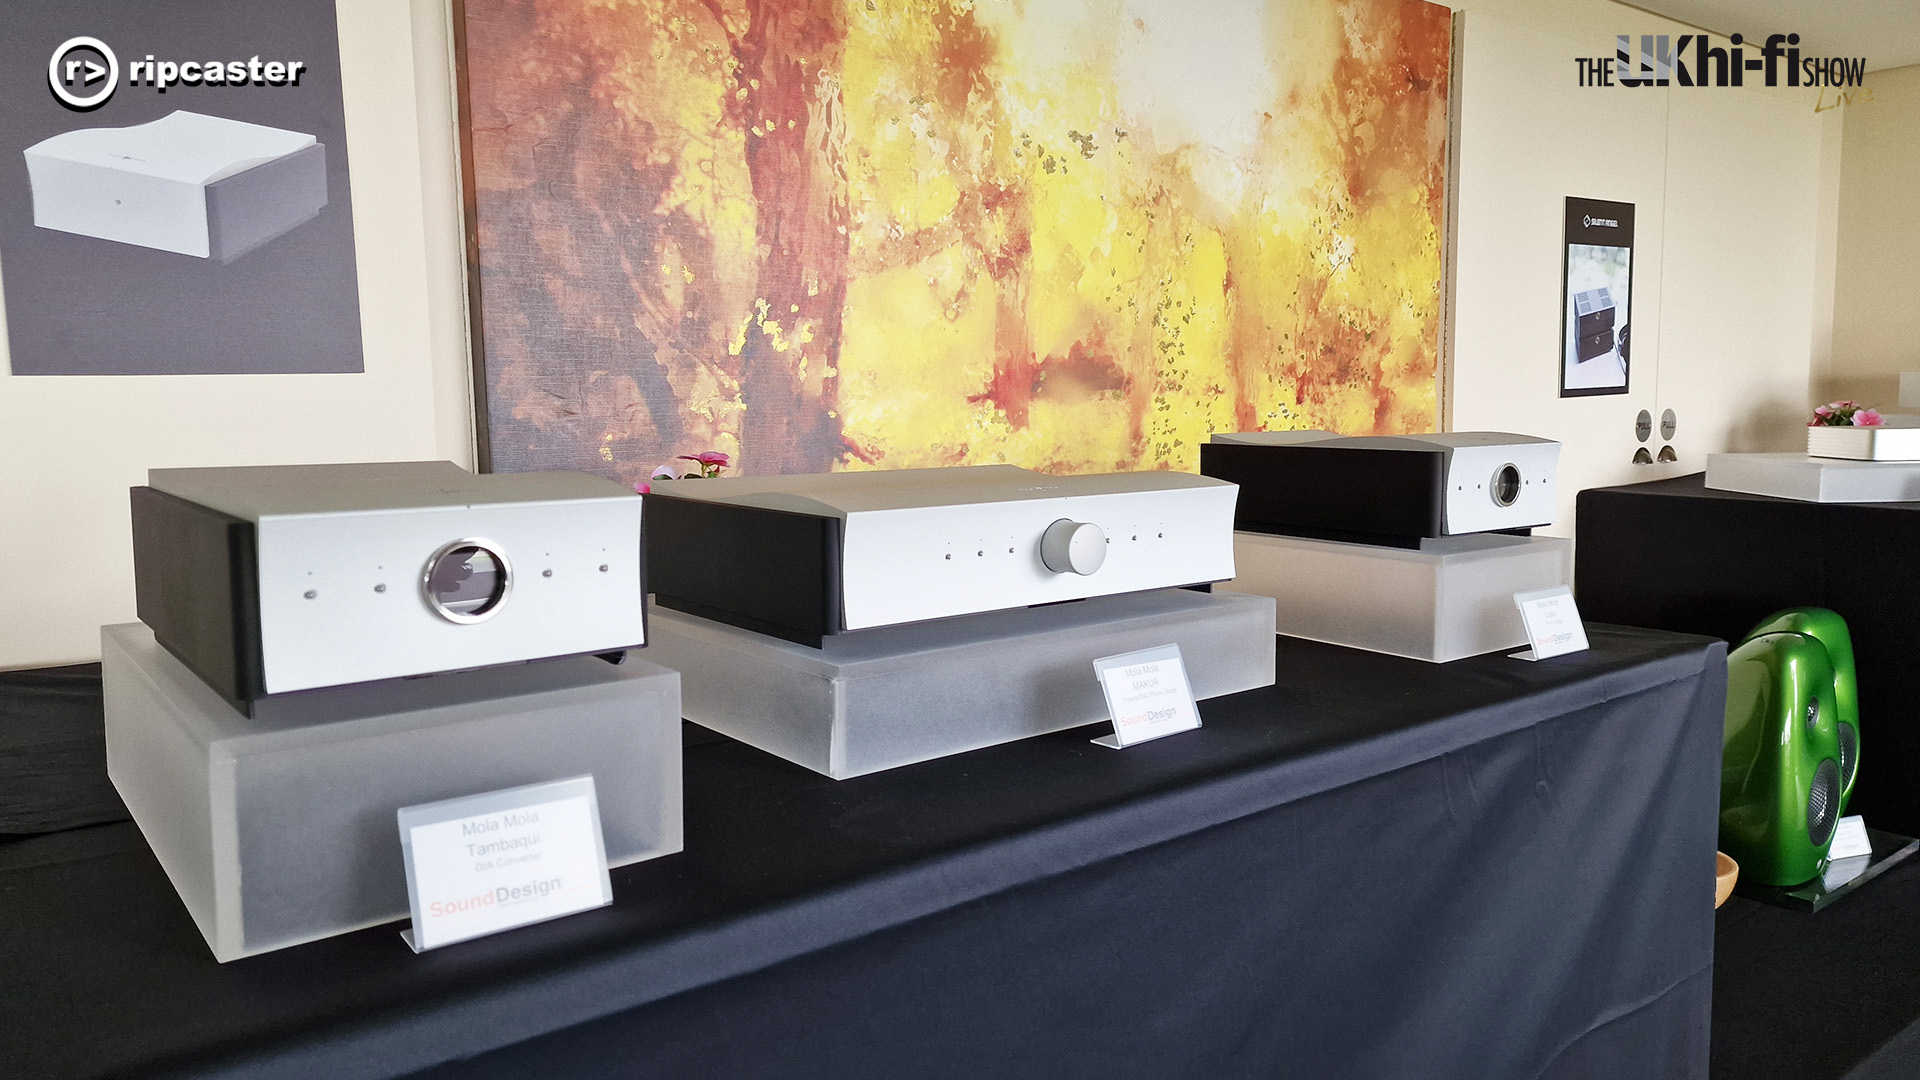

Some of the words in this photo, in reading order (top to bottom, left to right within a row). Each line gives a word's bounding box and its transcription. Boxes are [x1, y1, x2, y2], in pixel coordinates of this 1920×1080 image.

[1120, 706, 1177, 727] SoundDesign
[462, 821, 499, 837] Mola
[503, 811, 540, 829] Mola
[466, 832, 541, 857] Tambaqui
[496, 851, 543, 868] Converter
[429, 876, 562, 917] SoundDesign
